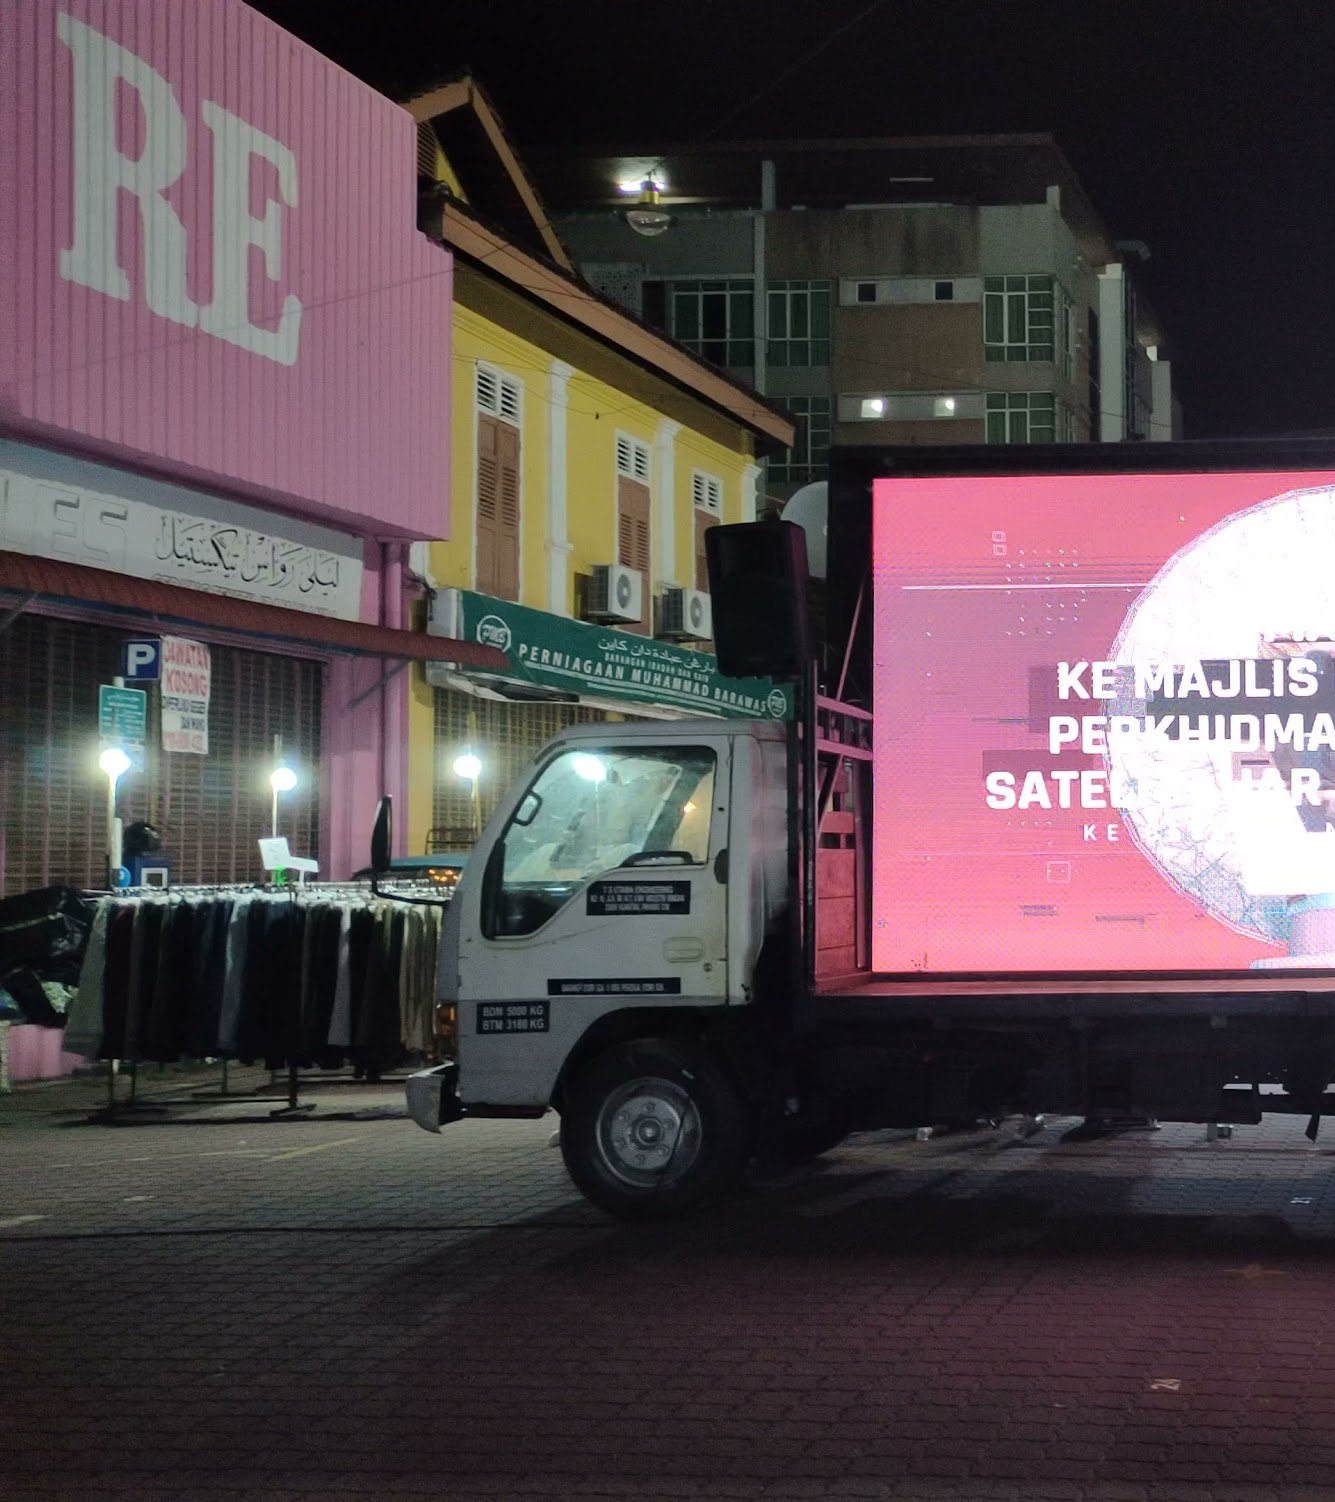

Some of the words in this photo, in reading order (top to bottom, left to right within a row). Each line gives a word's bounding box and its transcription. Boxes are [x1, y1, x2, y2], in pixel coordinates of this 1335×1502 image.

[57, 11, 302, 367] RE
[127, 643, 156, 676] P
[165, 668, 208, 698] KOSONG
[517, 642, 625, 681] PERNIAGAAN
[631, 668, 710, 697] MUHAMMAD
[713, 686, 767, 713] BARAWAS
[1057, 660, 1118, 700] KE
[1134, 657, 1320, 700] MAJLIS
[482, 1019, 503, 1030] BTM
[530, 1018, 544, 1029] KG
[530, 1005, 544, 1016] KG
